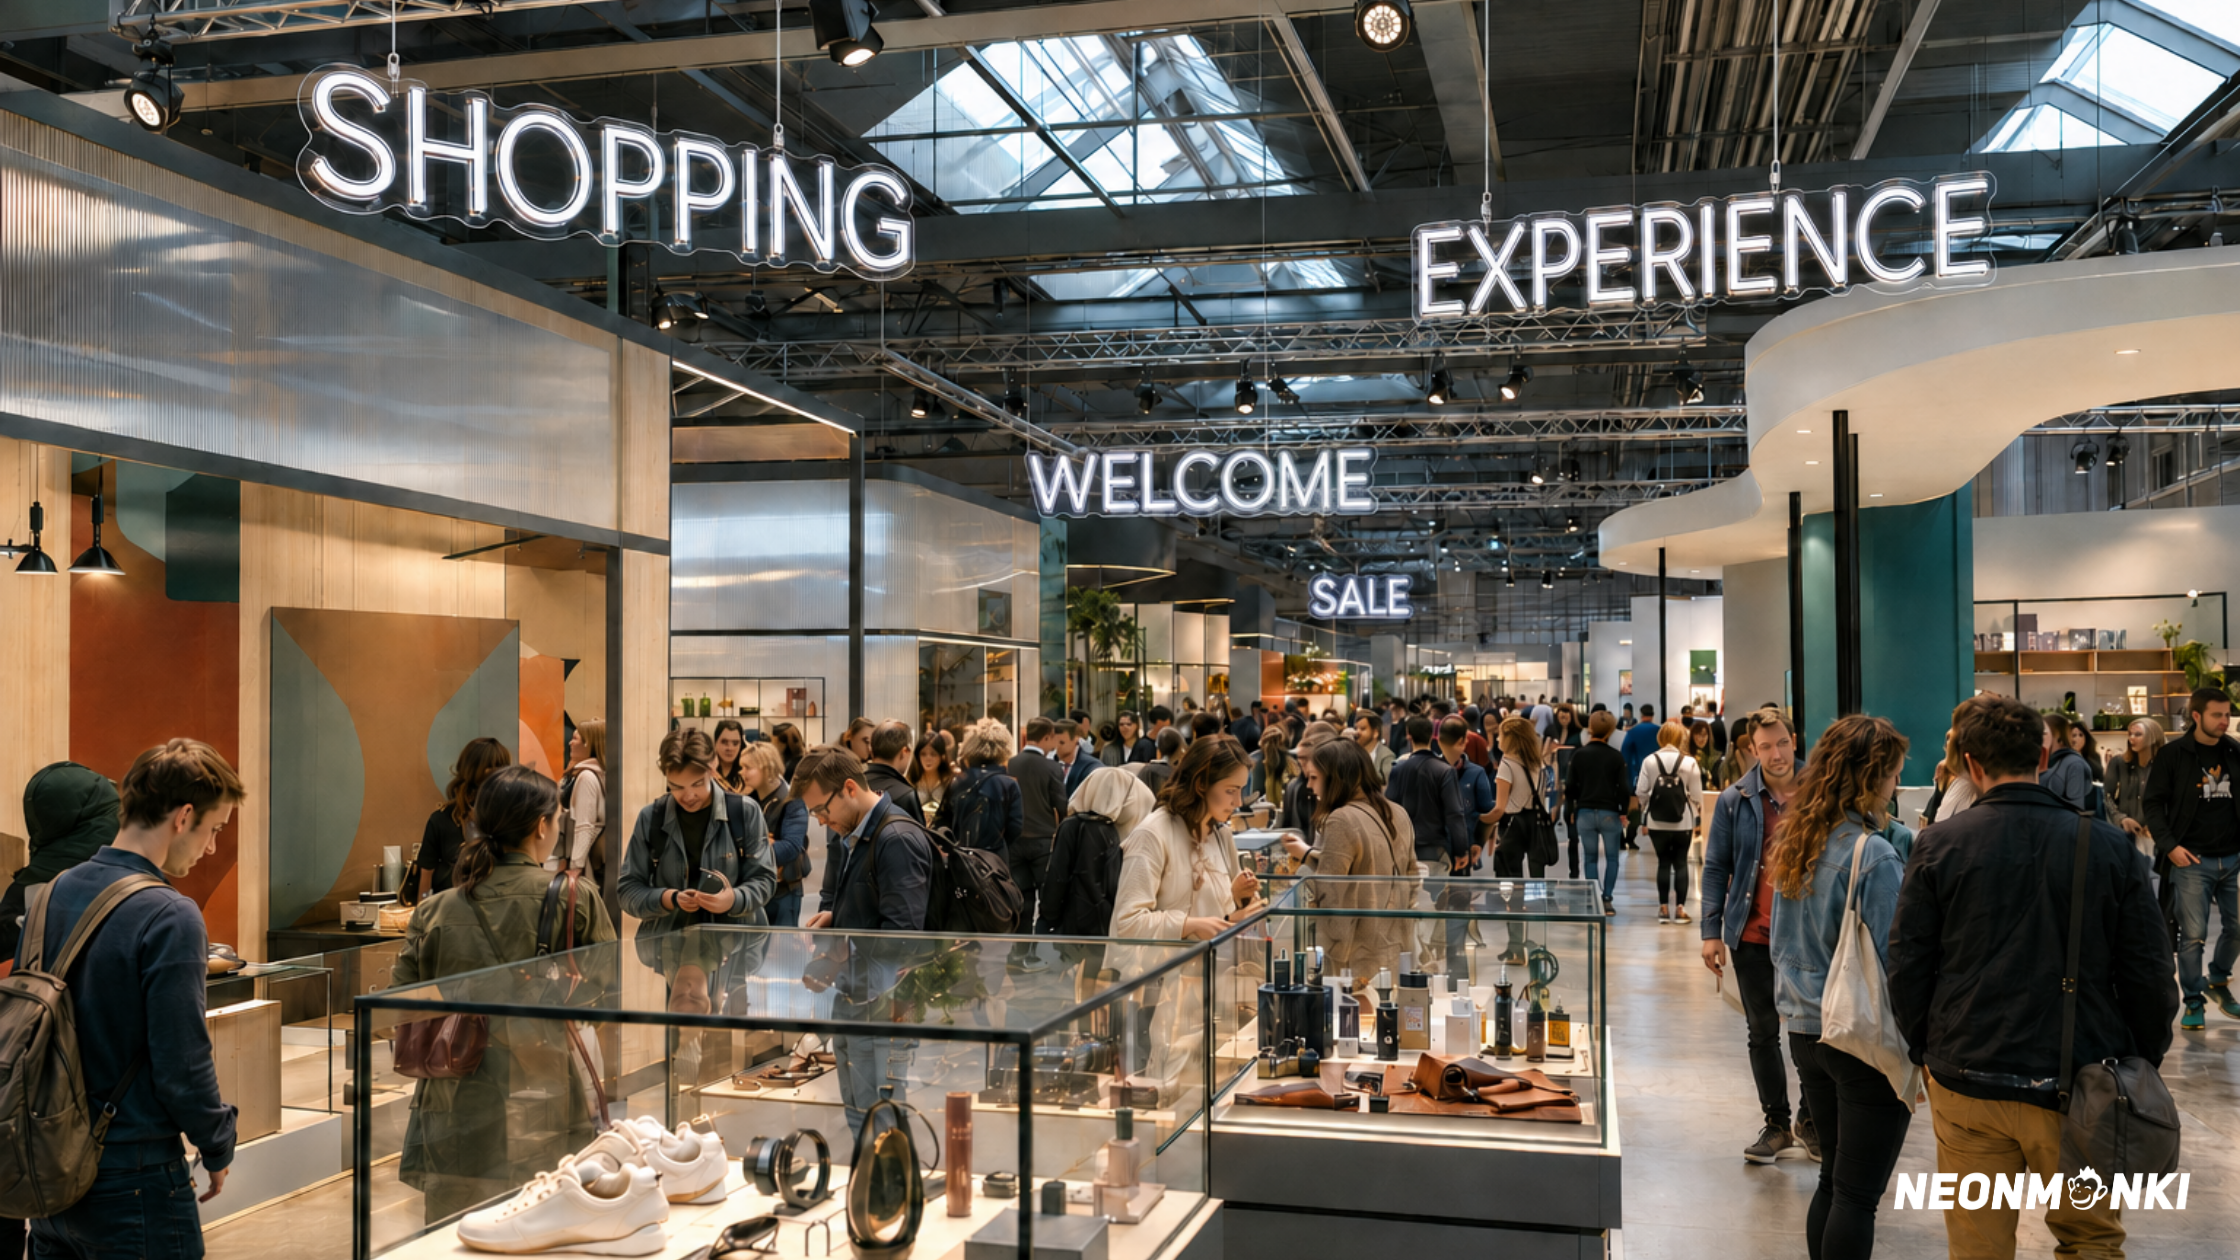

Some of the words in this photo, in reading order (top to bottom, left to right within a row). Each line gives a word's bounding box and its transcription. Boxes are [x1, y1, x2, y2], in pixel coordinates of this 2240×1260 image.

[312, 70, 911, 271] SHOPPING
[1418, 178, 1989, 315] EXPERIENCE
[1027, 449, 1375, 513] WELCOME
[1311, 576, 1411, 617] SALE
